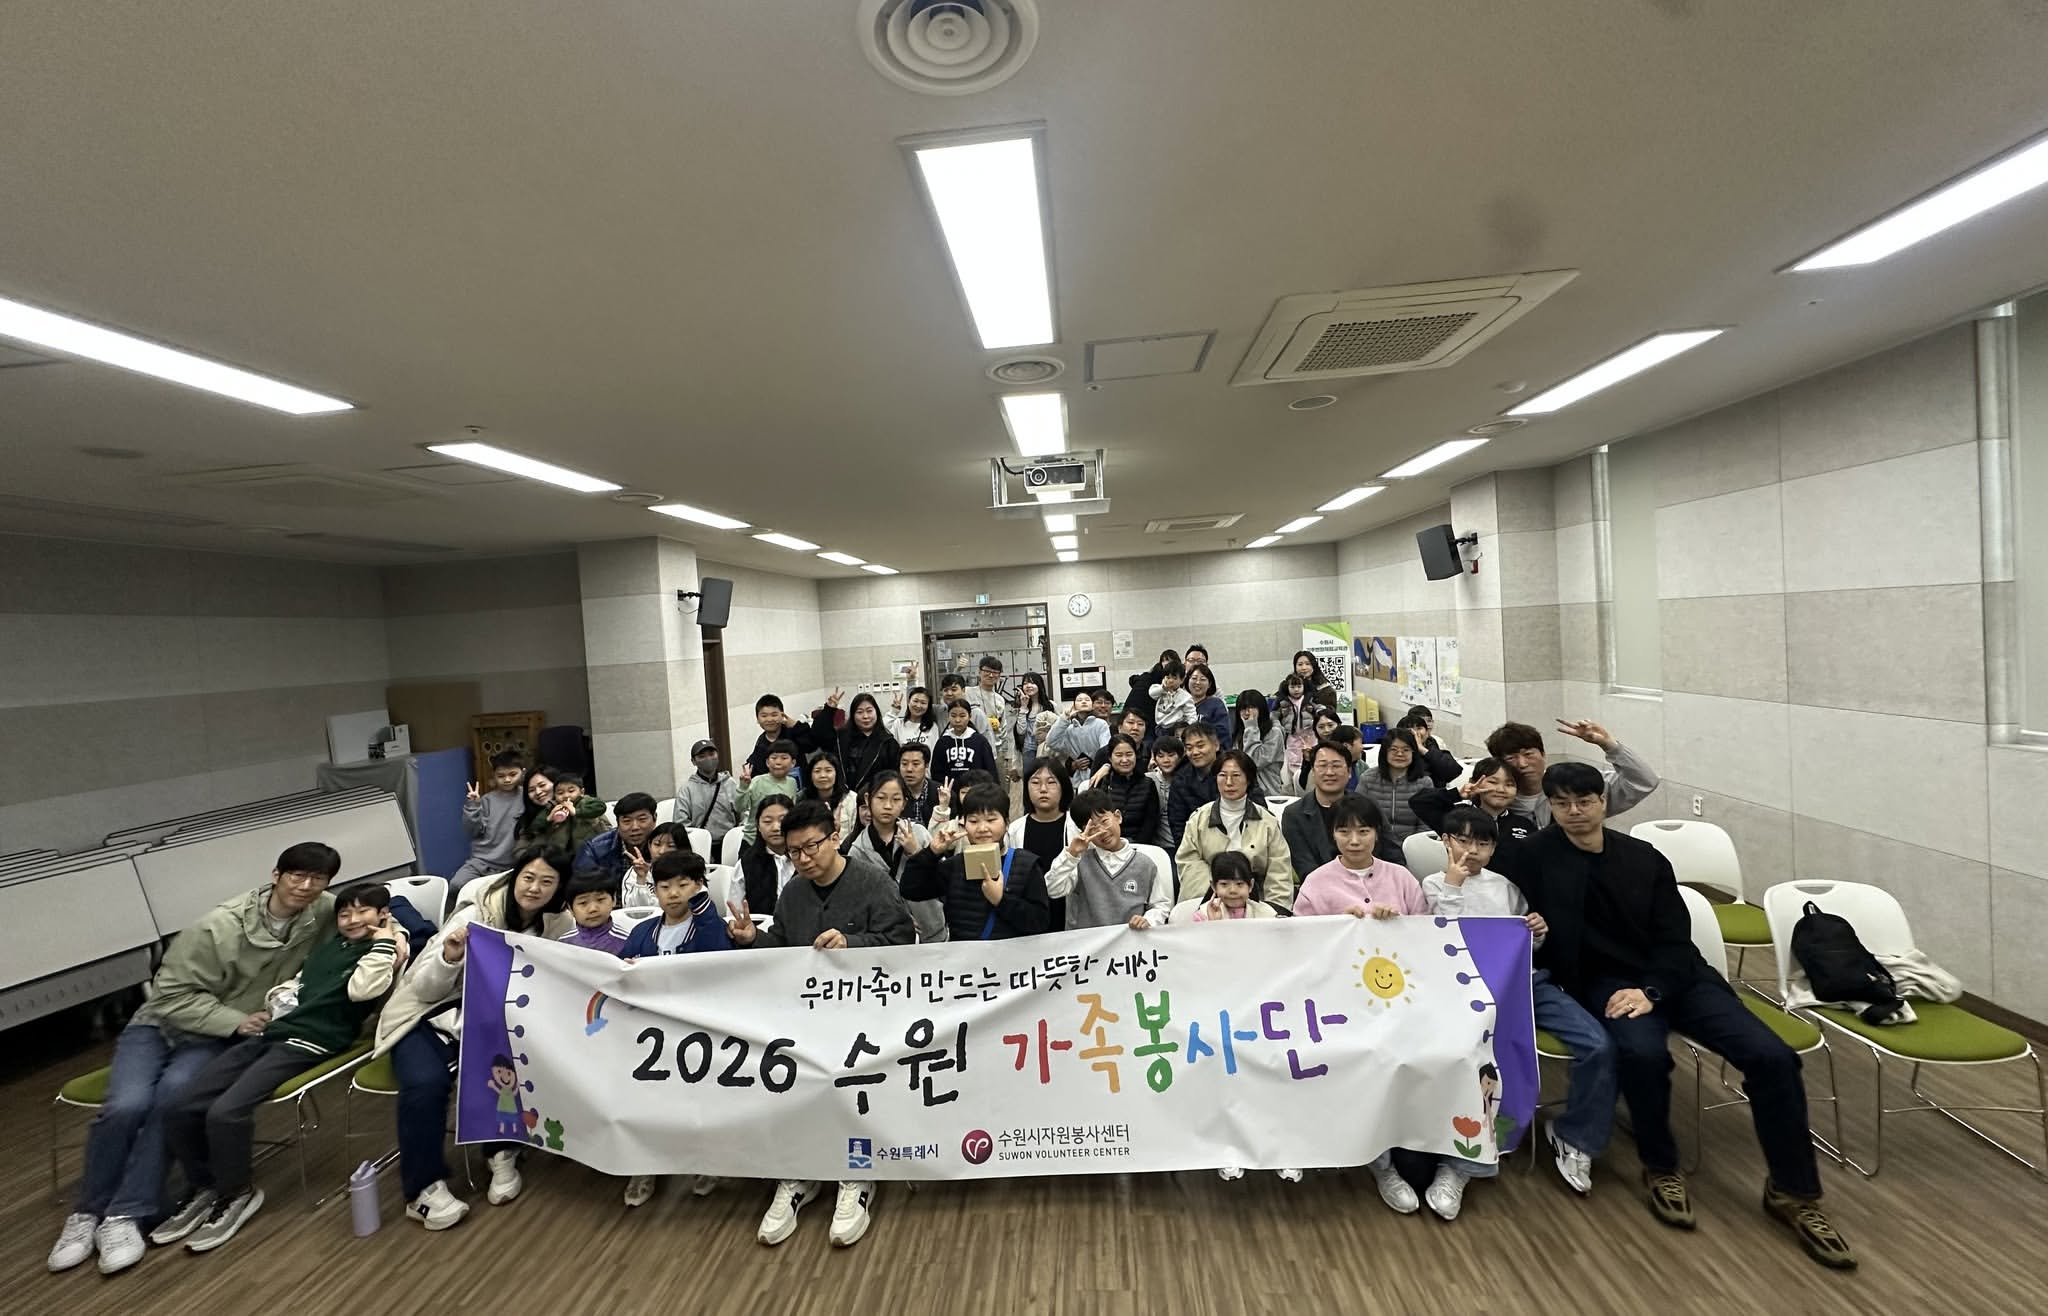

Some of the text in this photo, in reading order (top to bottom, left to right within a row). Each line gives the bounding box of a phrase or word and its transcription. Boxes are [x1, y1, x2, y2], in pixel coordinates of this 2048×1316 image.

[946, 747, 975, 763] 1997
[800, 949, 1169, 1009] 우리가족이 만드는 따뜻한 세상
[632, 990, 1348, 1115] 2026 수원 가족봉사단
[998, 1124, 1130, 1147] 수원시자원봉사센터
[876, 1144, 939, 1161] 수원특례시
[998, 1147, 1130, 1161] SUWON VOLUNTEER CENTER
